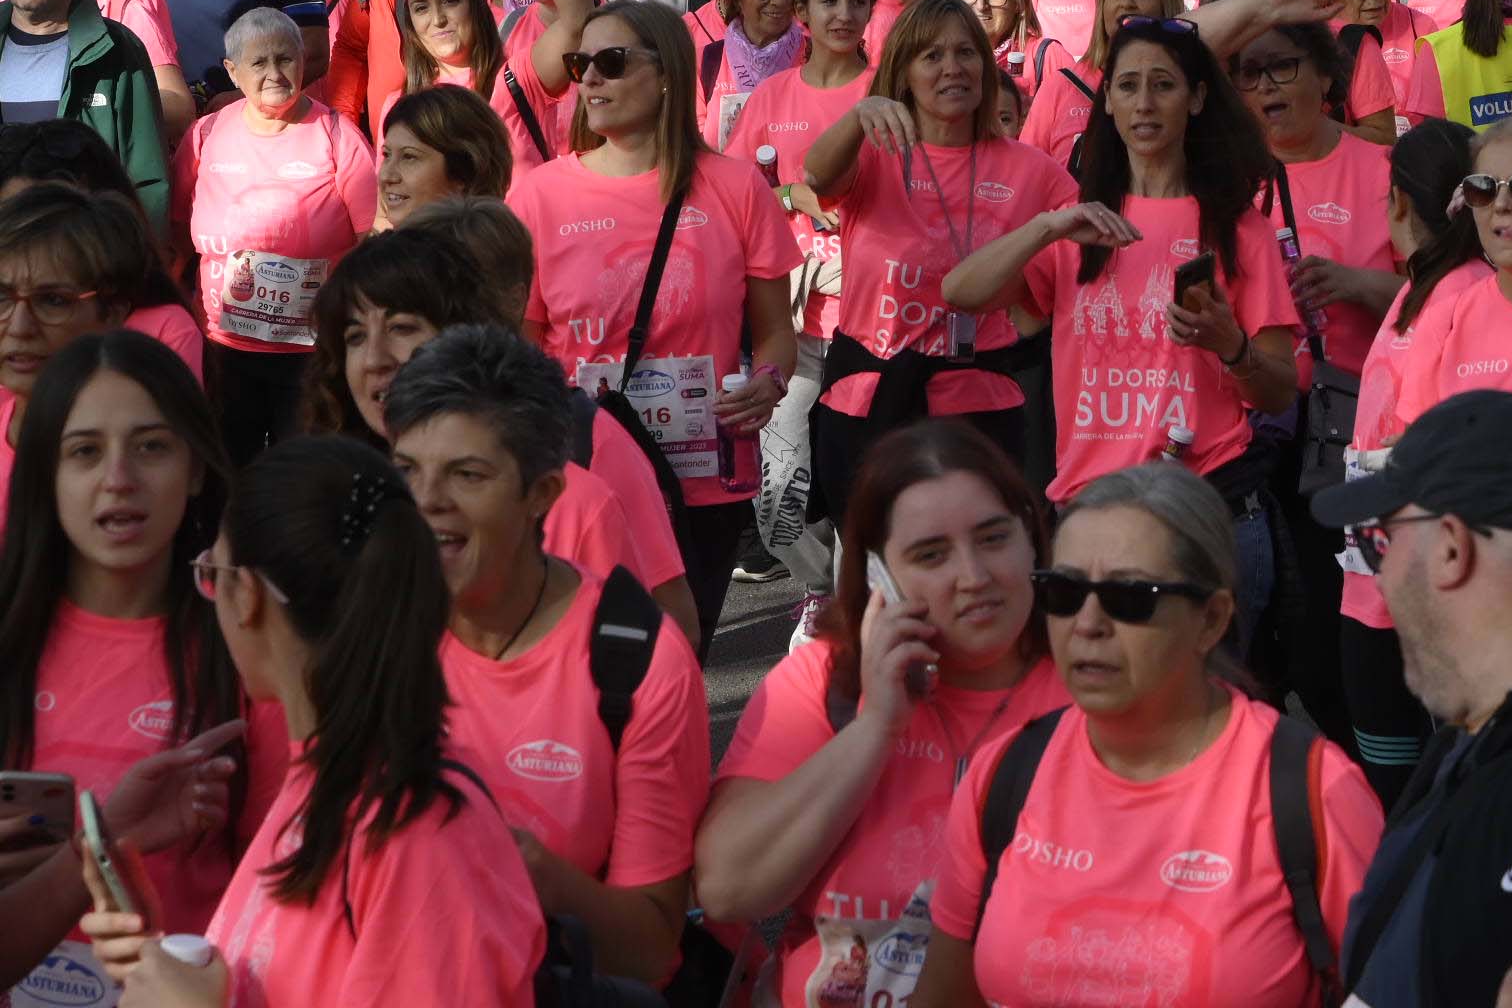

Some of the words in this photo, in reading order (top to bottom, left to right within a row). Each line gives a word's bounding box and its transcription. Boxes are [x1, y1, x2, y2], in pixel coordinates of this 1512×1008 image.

[768, 121, 808, 133] OYSHO
[560, 217, 616, 236] OYSHO
[258, 265, 296, 280] ASTURIANA
[885, 259, 922, 289] TU
[257, 286, 290, 303] 016
[258, 302, 284, 314] 29765
[568, 317, 606, 345] TU
[679, 372, 705, 381] SUMA
[1456, 359, 1508, 377] OYSHO
[1109, 367, 1196, 393] DORSAL
[1075, 389, 1187, 428] SUMA
[514, 752, 581, 773] ASTURIANA
